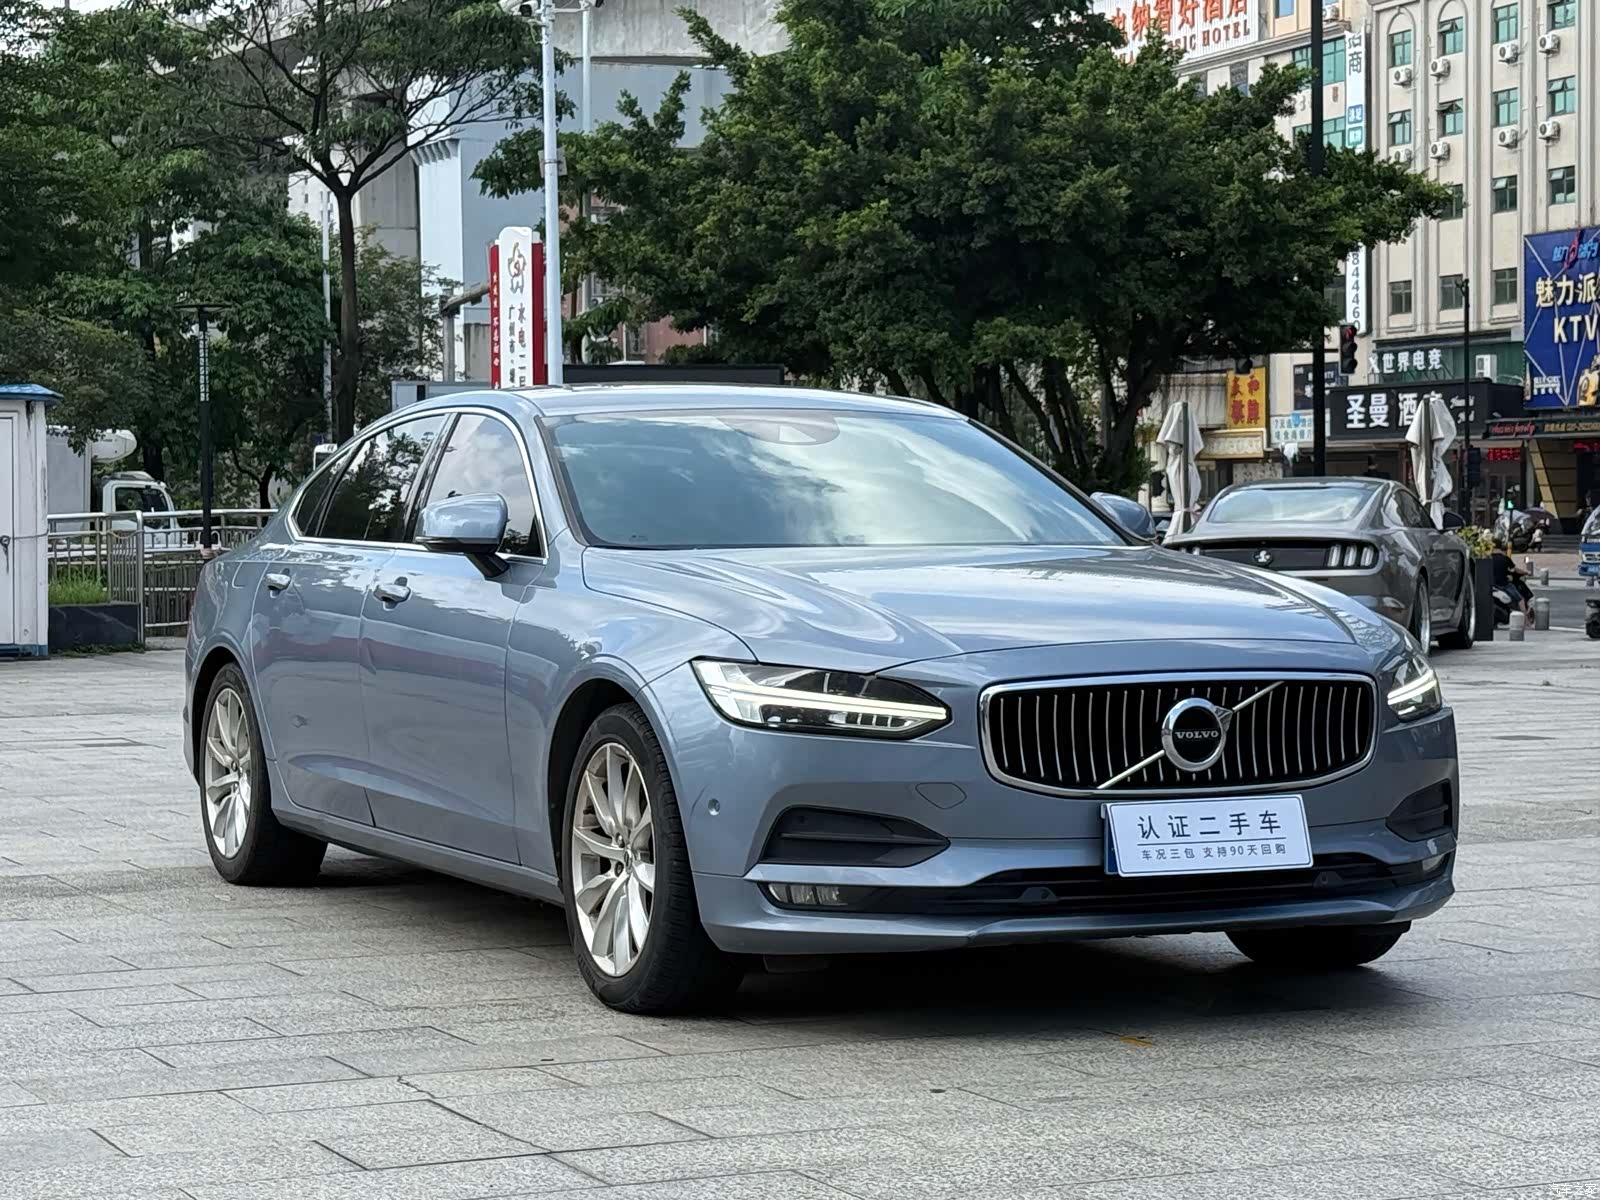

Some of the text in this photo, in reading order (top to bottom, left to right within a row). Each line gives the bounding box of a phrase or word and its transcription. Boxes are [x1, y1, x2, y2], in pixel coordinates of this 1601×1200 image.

[1202, 19, 1251, 47] HOTEL
[1553, 313, 1599, 344] KTV
[1175, 730, 1219, 739] VOLVO
[1138, 810, 1281, 840] 认证二手车
[1142, 843, 1287, 860] 车况三包 支持90天回购
